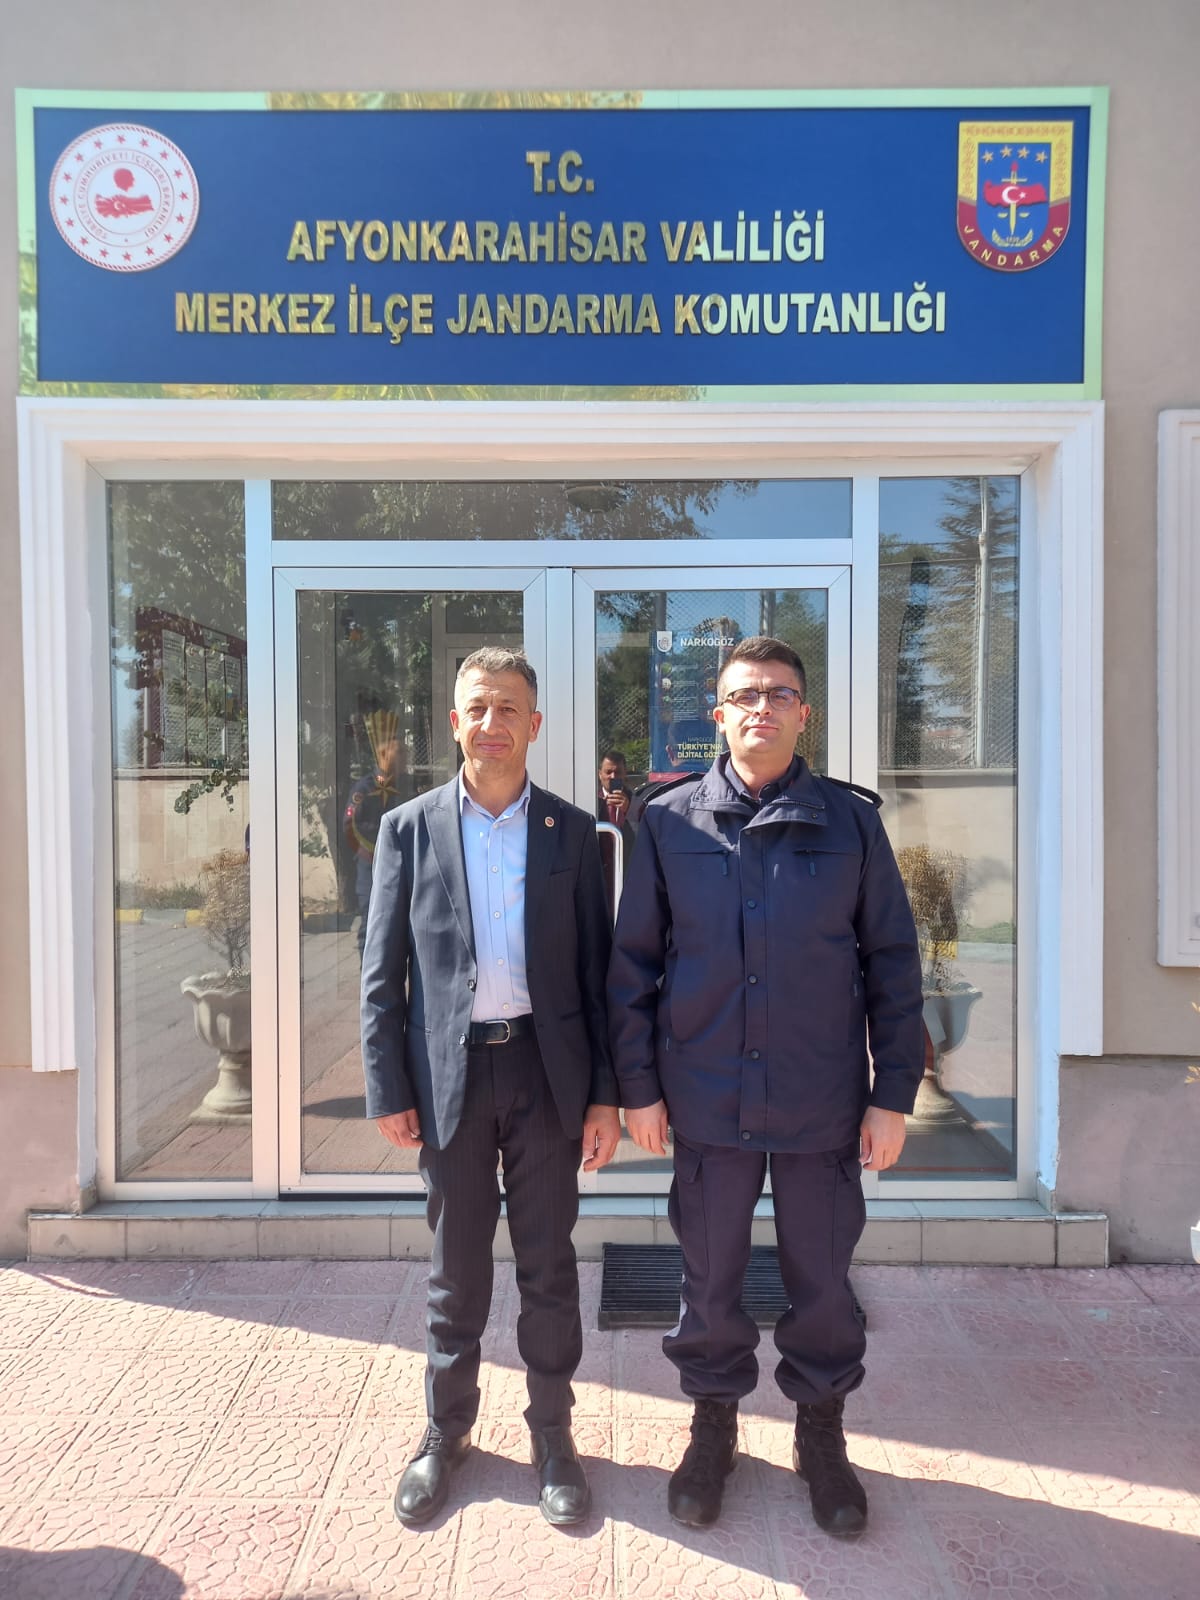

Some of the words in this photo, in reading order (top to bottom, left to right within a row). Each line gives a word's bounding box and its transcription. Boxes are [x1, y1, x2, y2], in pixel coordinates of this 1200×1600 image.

[526, 151, 594, 193] T.C.
[286, 211, 647, 263] AFYONKARAHİSAR
[660, 209, 825, 262] VALİLİĞİ
[963, 225, 1063, 266] JANDARMA
[175, 292, 335, 335] MERKEZ
[349, 284, 434, 344] İLÇE
[446, 293, 661, 335] JANDARMA
[674, 281, 946, 334] KOMUTANLIĞI
[680, 636, 735, 647] NARKOGÖZ
[677, 750, 703, 759] DİJİTAL
